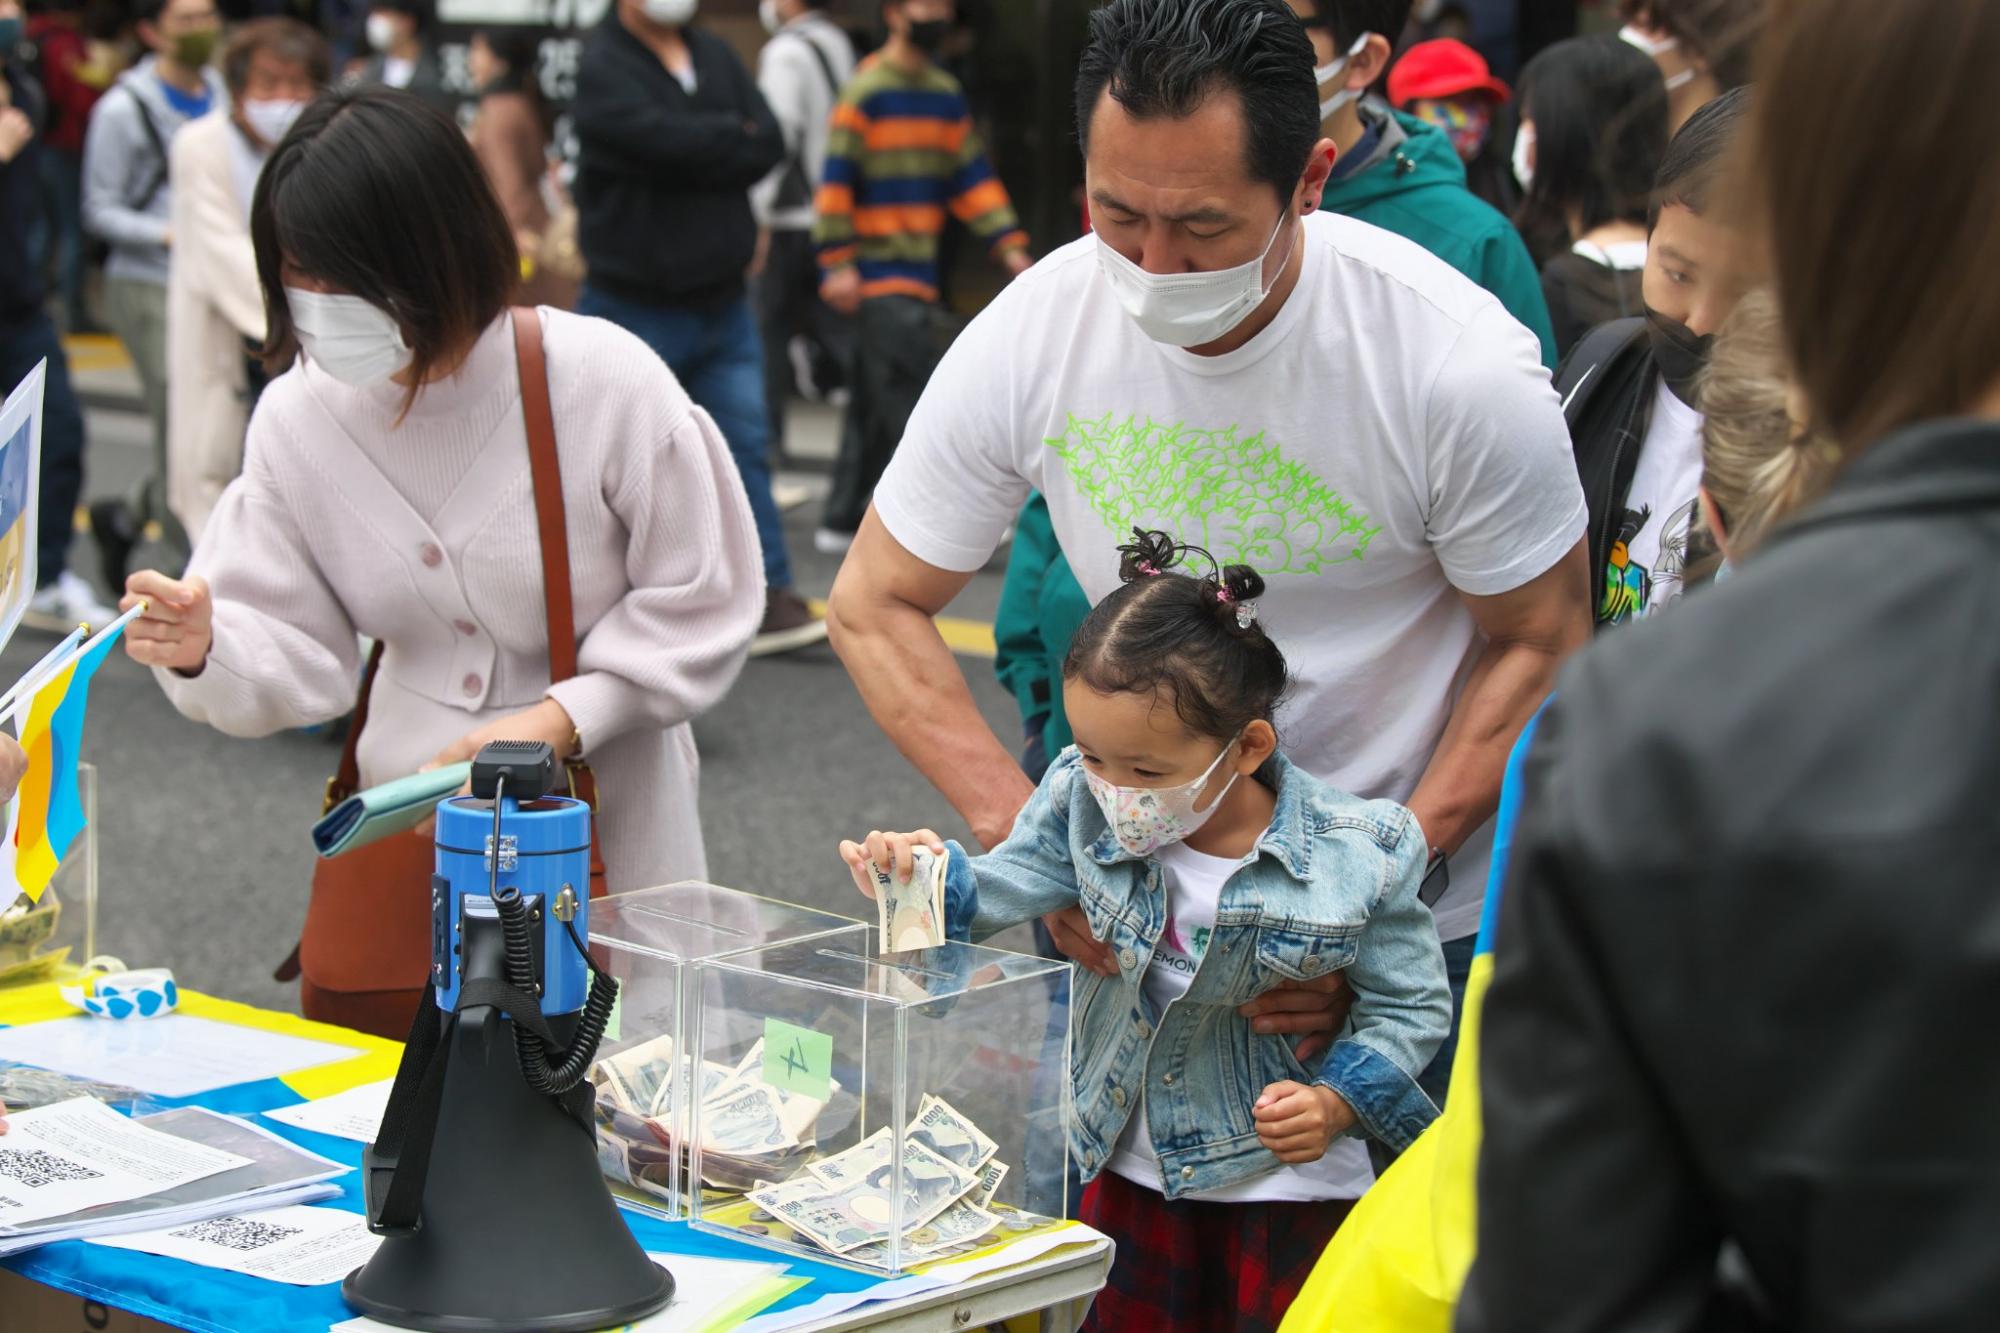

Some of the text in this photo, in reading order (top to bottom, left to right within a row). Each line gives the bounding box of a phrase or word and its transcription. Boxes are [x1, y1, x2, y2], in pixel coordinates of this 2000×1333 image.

[1153, 949, 1196, 973] EMON
[920, 1105, 944, 1127] 1000
[982, 1168, 1002, 1191] 1000
